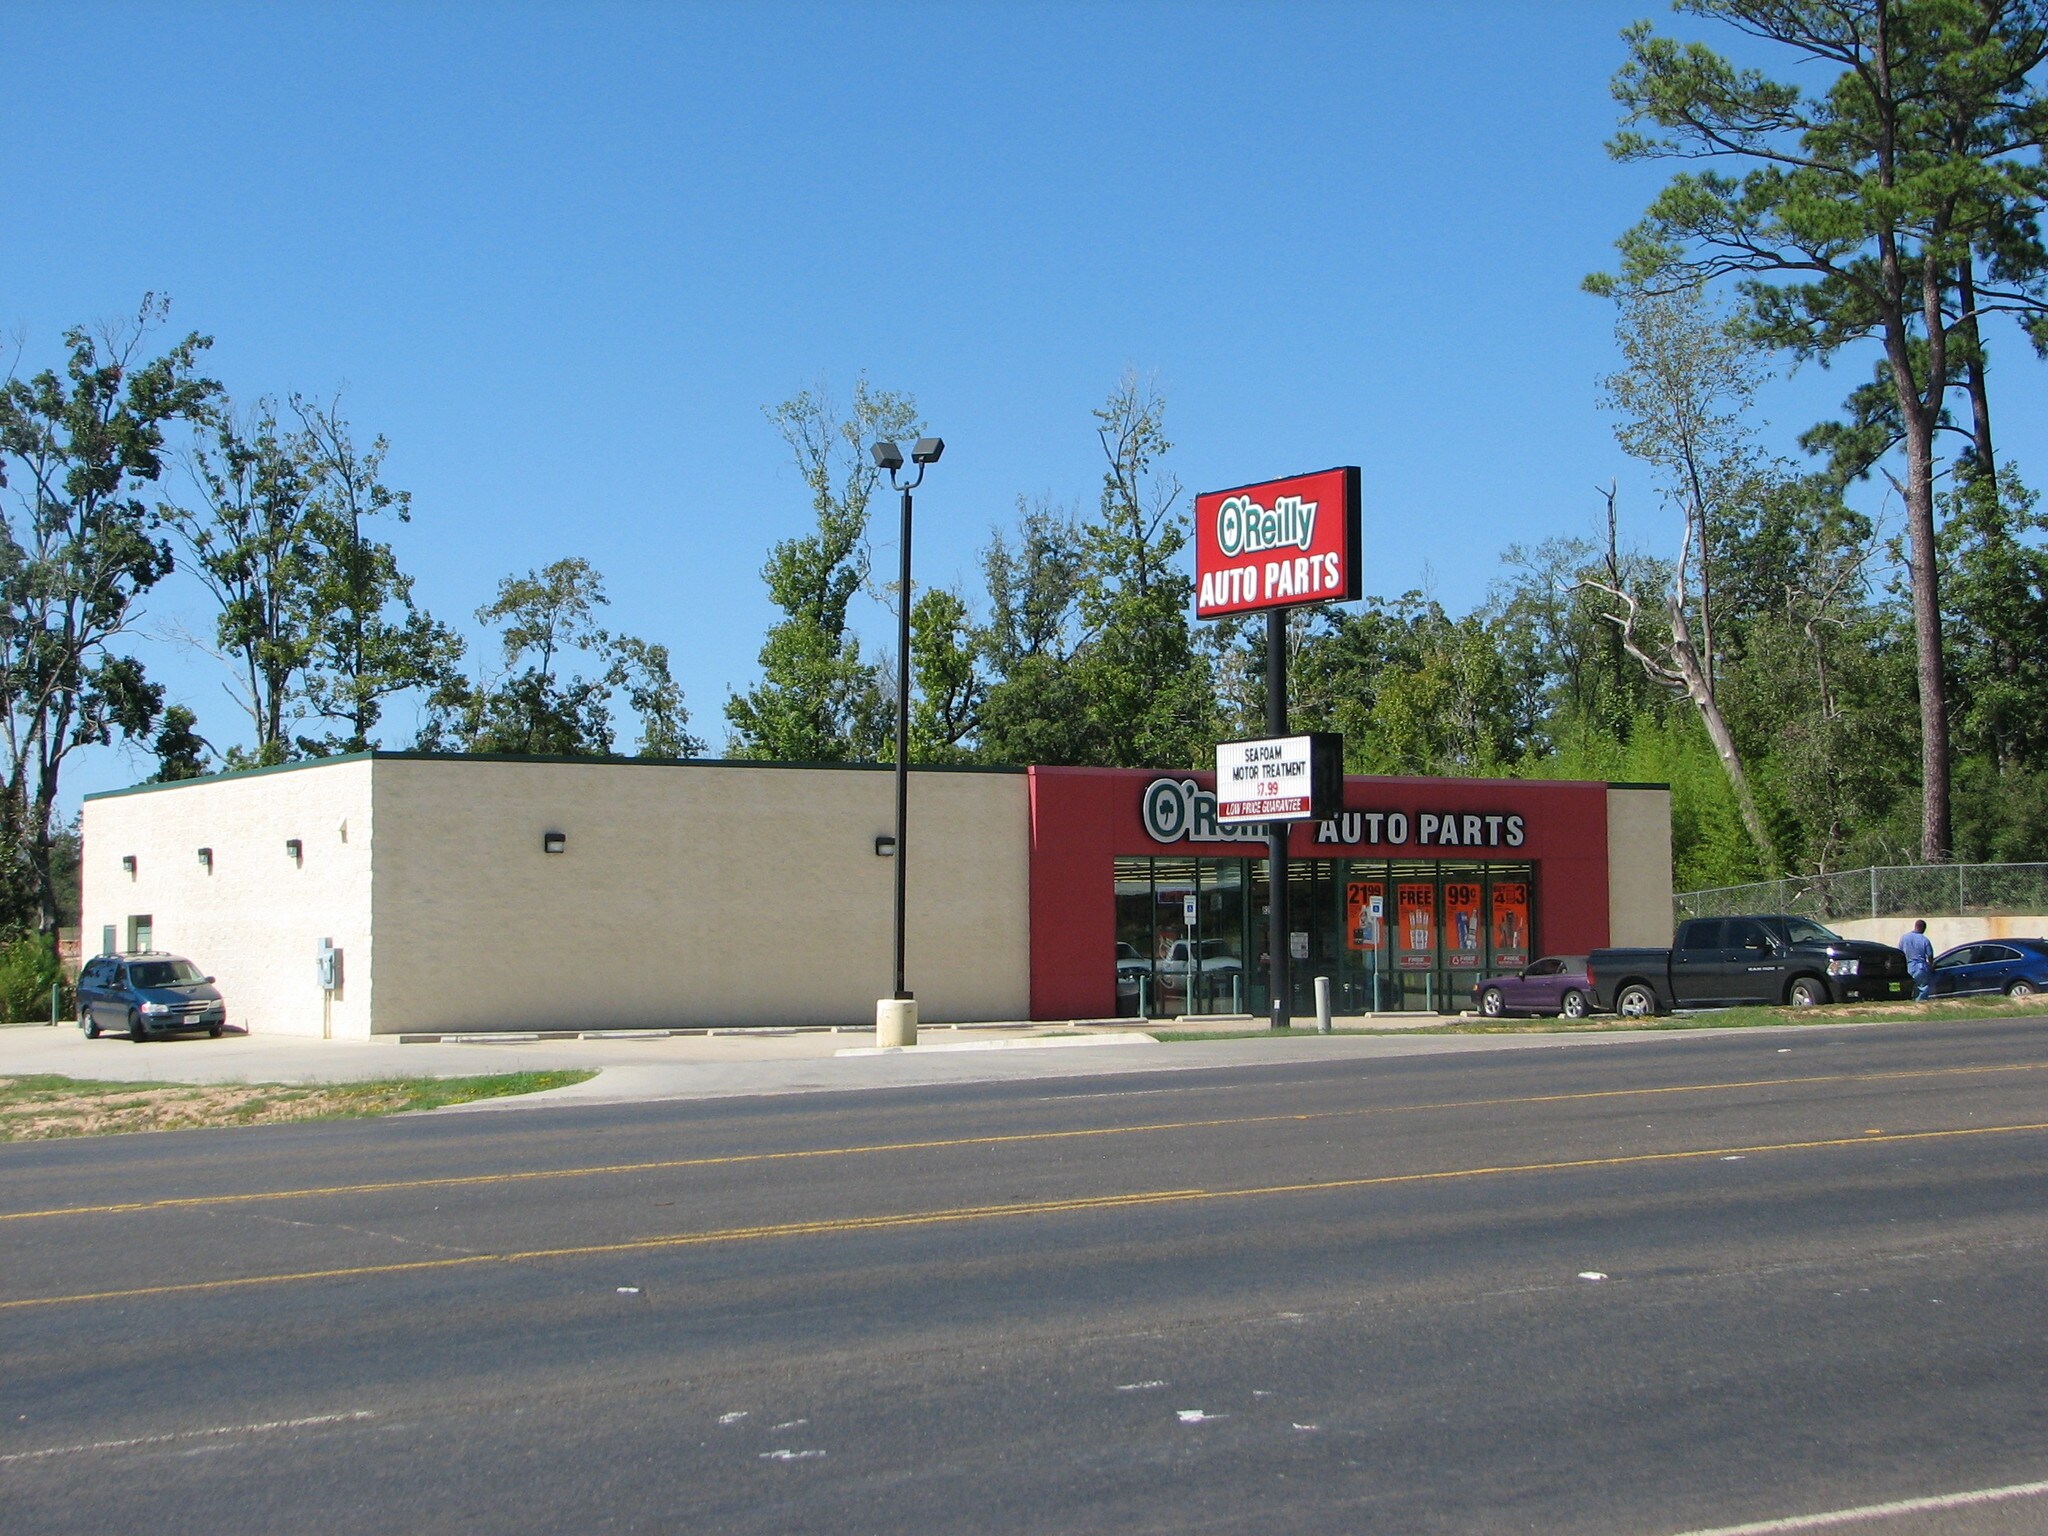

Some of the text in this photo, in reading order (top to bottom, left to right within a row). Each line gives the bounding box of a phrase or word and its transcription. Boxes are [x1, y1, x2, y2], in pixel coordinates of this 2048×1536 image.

[1217, 495, 1317, 557] O'Reilly
[1199, 552, 1339, 608] AUTO PARTS
[1233, 761, 1306, 780] MOTOR TREATMENT
[1226, 799, 1302, 815] LOW PRICE GUARANTEE
[1318, 812, 1524, 846] AUTO PARTS
[1400, 890, 1432, 905] FREE
[1516, 885, 1526, 905] 3
